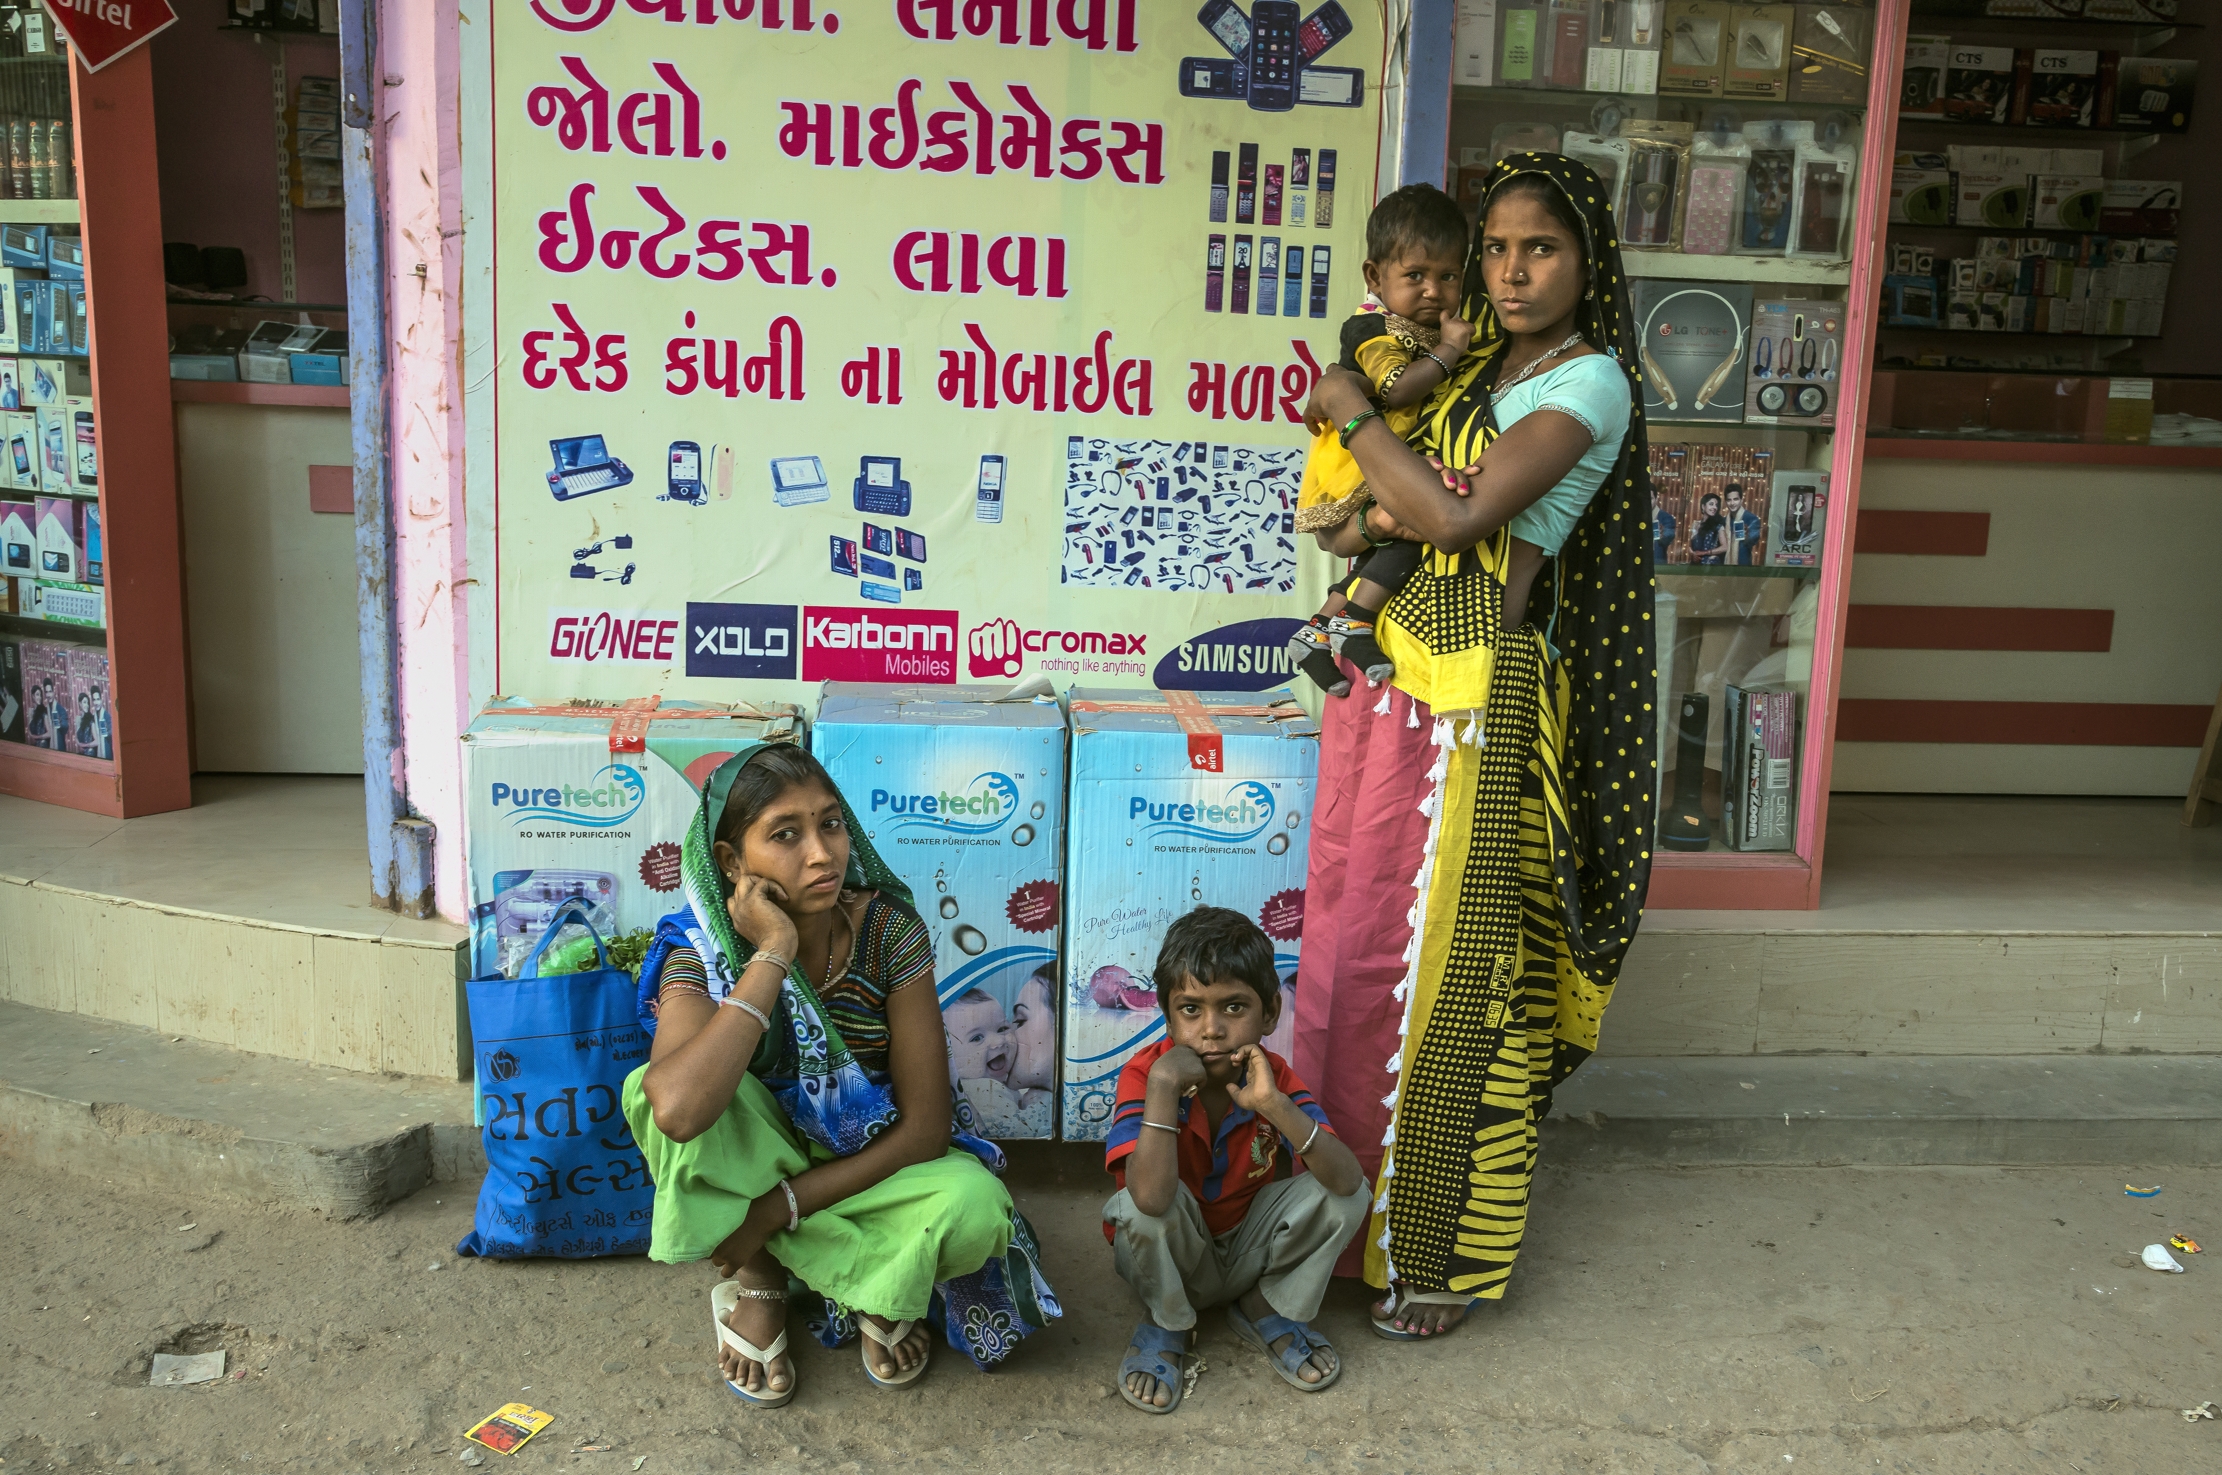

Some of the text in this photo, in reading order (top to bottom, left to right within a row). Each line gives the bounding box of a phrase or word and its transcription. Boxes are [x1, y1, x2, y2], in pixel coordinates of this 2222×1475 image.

[1955, 52, 1983, 65] CTS
[2040, 56, 2067, 69] CTS
[527, 55, 728, 161] જોલો.
[892, 230, 1068, 299] લાવા
[1674, 326, 1728, 337] LG TONE+
[522, 302, 1322, 424] દરેક કંપની ના મોબાઈલ મળશે
[1701, 460, 1730, 469] GALAXY
[694, 624, 789, 658] XOLO
[806, 615, 953, 652] Karbonn
[885, 653, 951, 678] Mobiles
[1041, 657, 1146, 677] nothing like anything
[1210, 749, 1218, 770] airtel
[492, 781, 627, 808] Puretech
[871, 789, 1000, 816] Puretech
[1748, 748, 1765, 839] PowerZoom
[1130, 796, 1256, 824] Puretech
[942, 838, 1001, 846] PURIFICATION
[1168, 846, 1197, 854] WATER
[1198, 846, 1256, 855] PURIFICATION
[1084, 908, 1148, 934] Pure Water
[1106, 919, 1153, 940] Healthy
